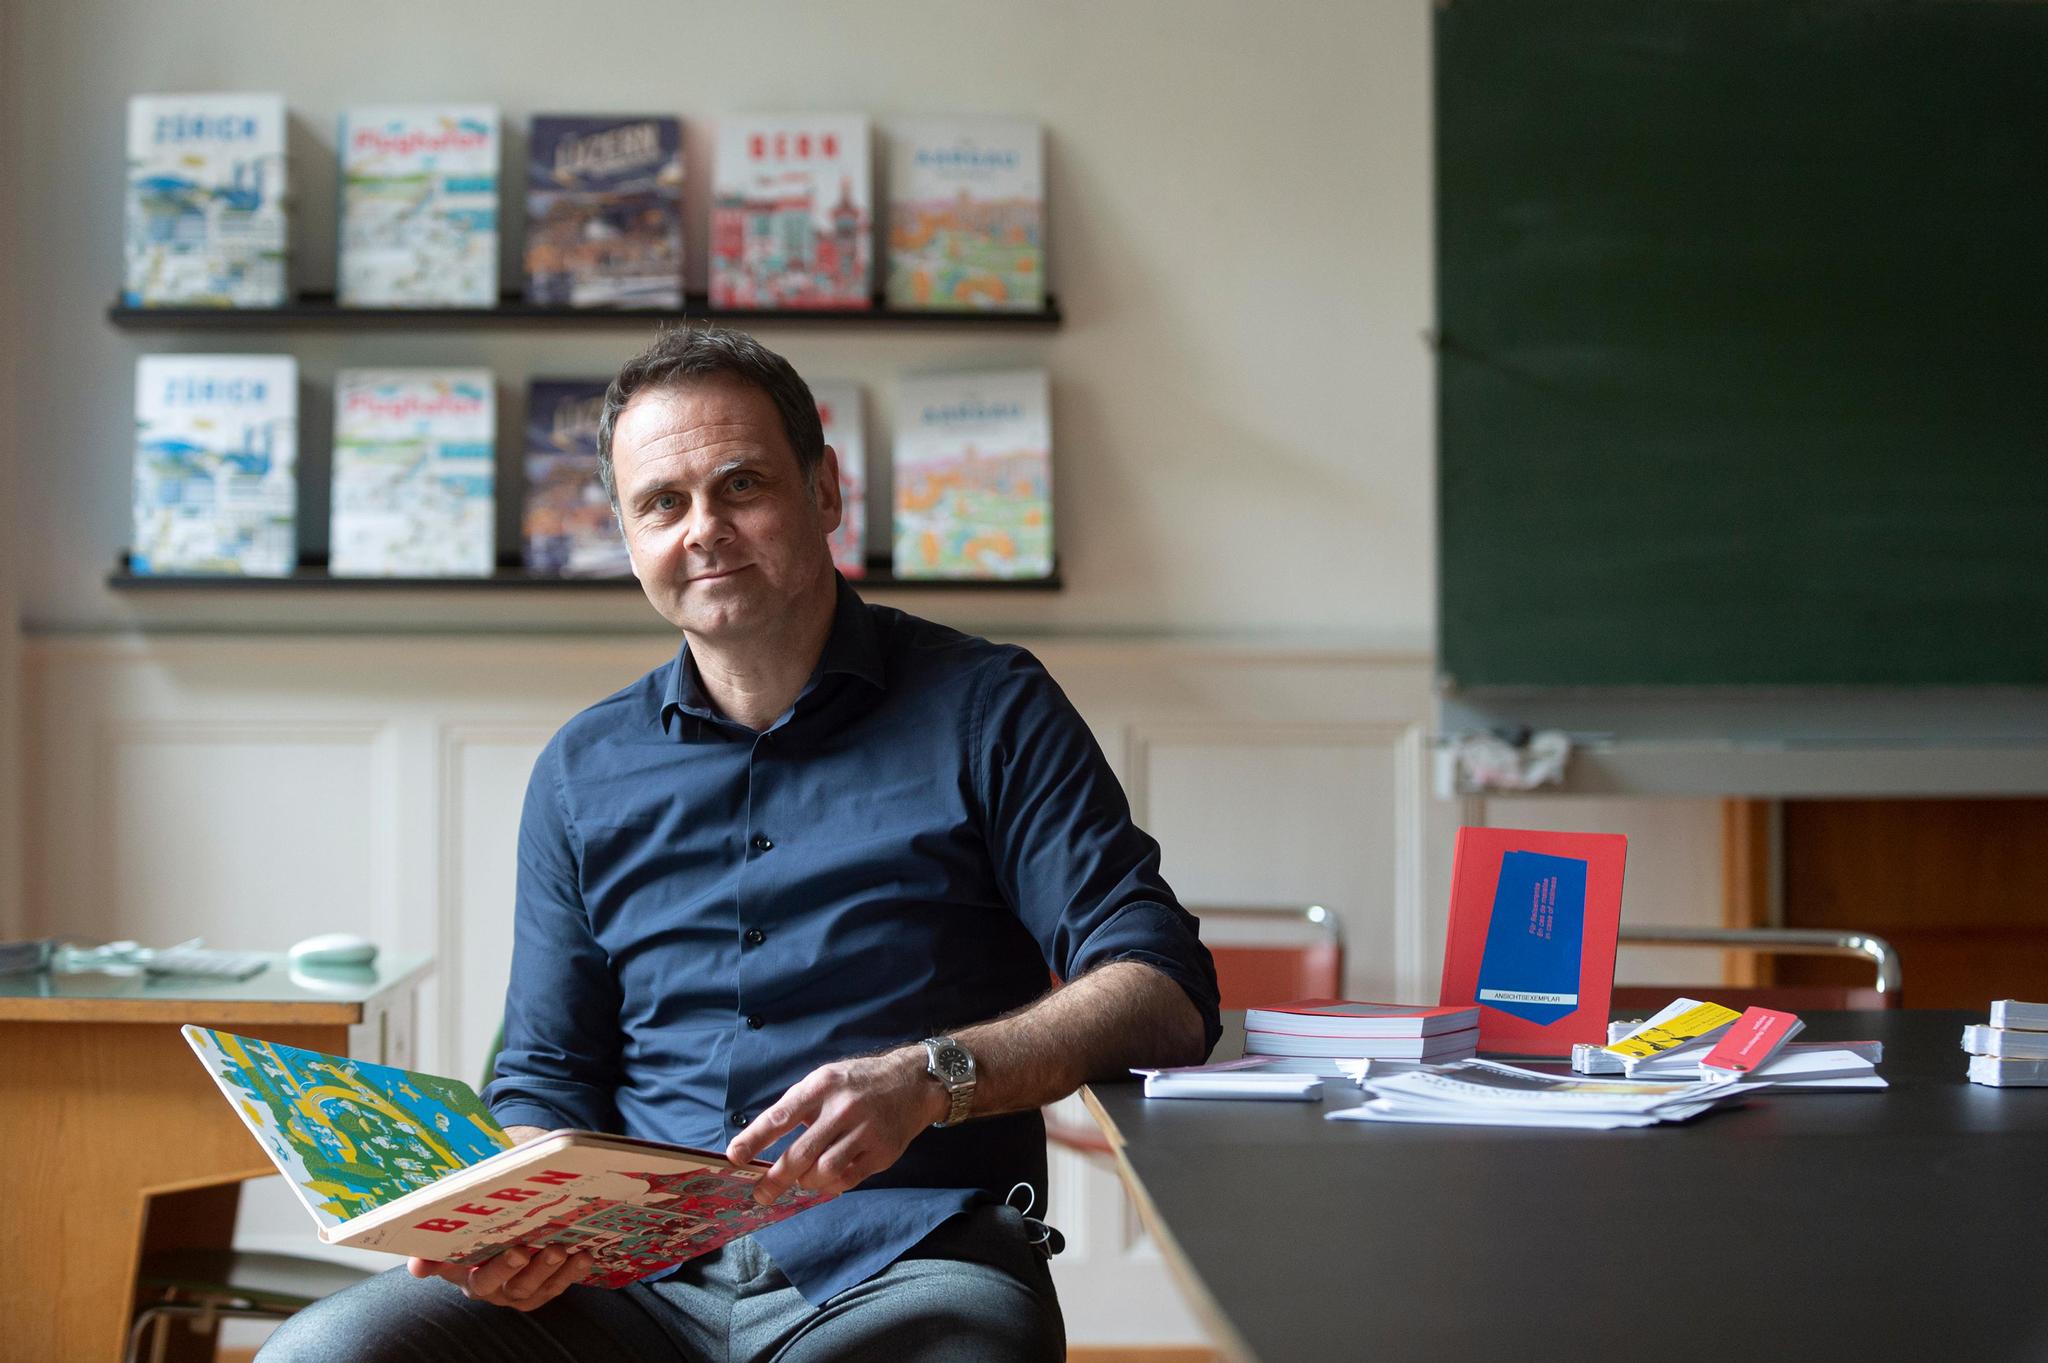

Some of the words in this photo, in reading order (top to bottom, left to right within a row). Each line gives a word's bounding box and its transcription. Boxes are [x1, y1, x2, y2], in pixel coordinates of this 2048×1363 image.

[748, 131, 839, 160] BERN
[1494, 992, 1560, 1003] ANSICHTSEXEMPLAR
[412, 1170, 583, 1233] BERN
